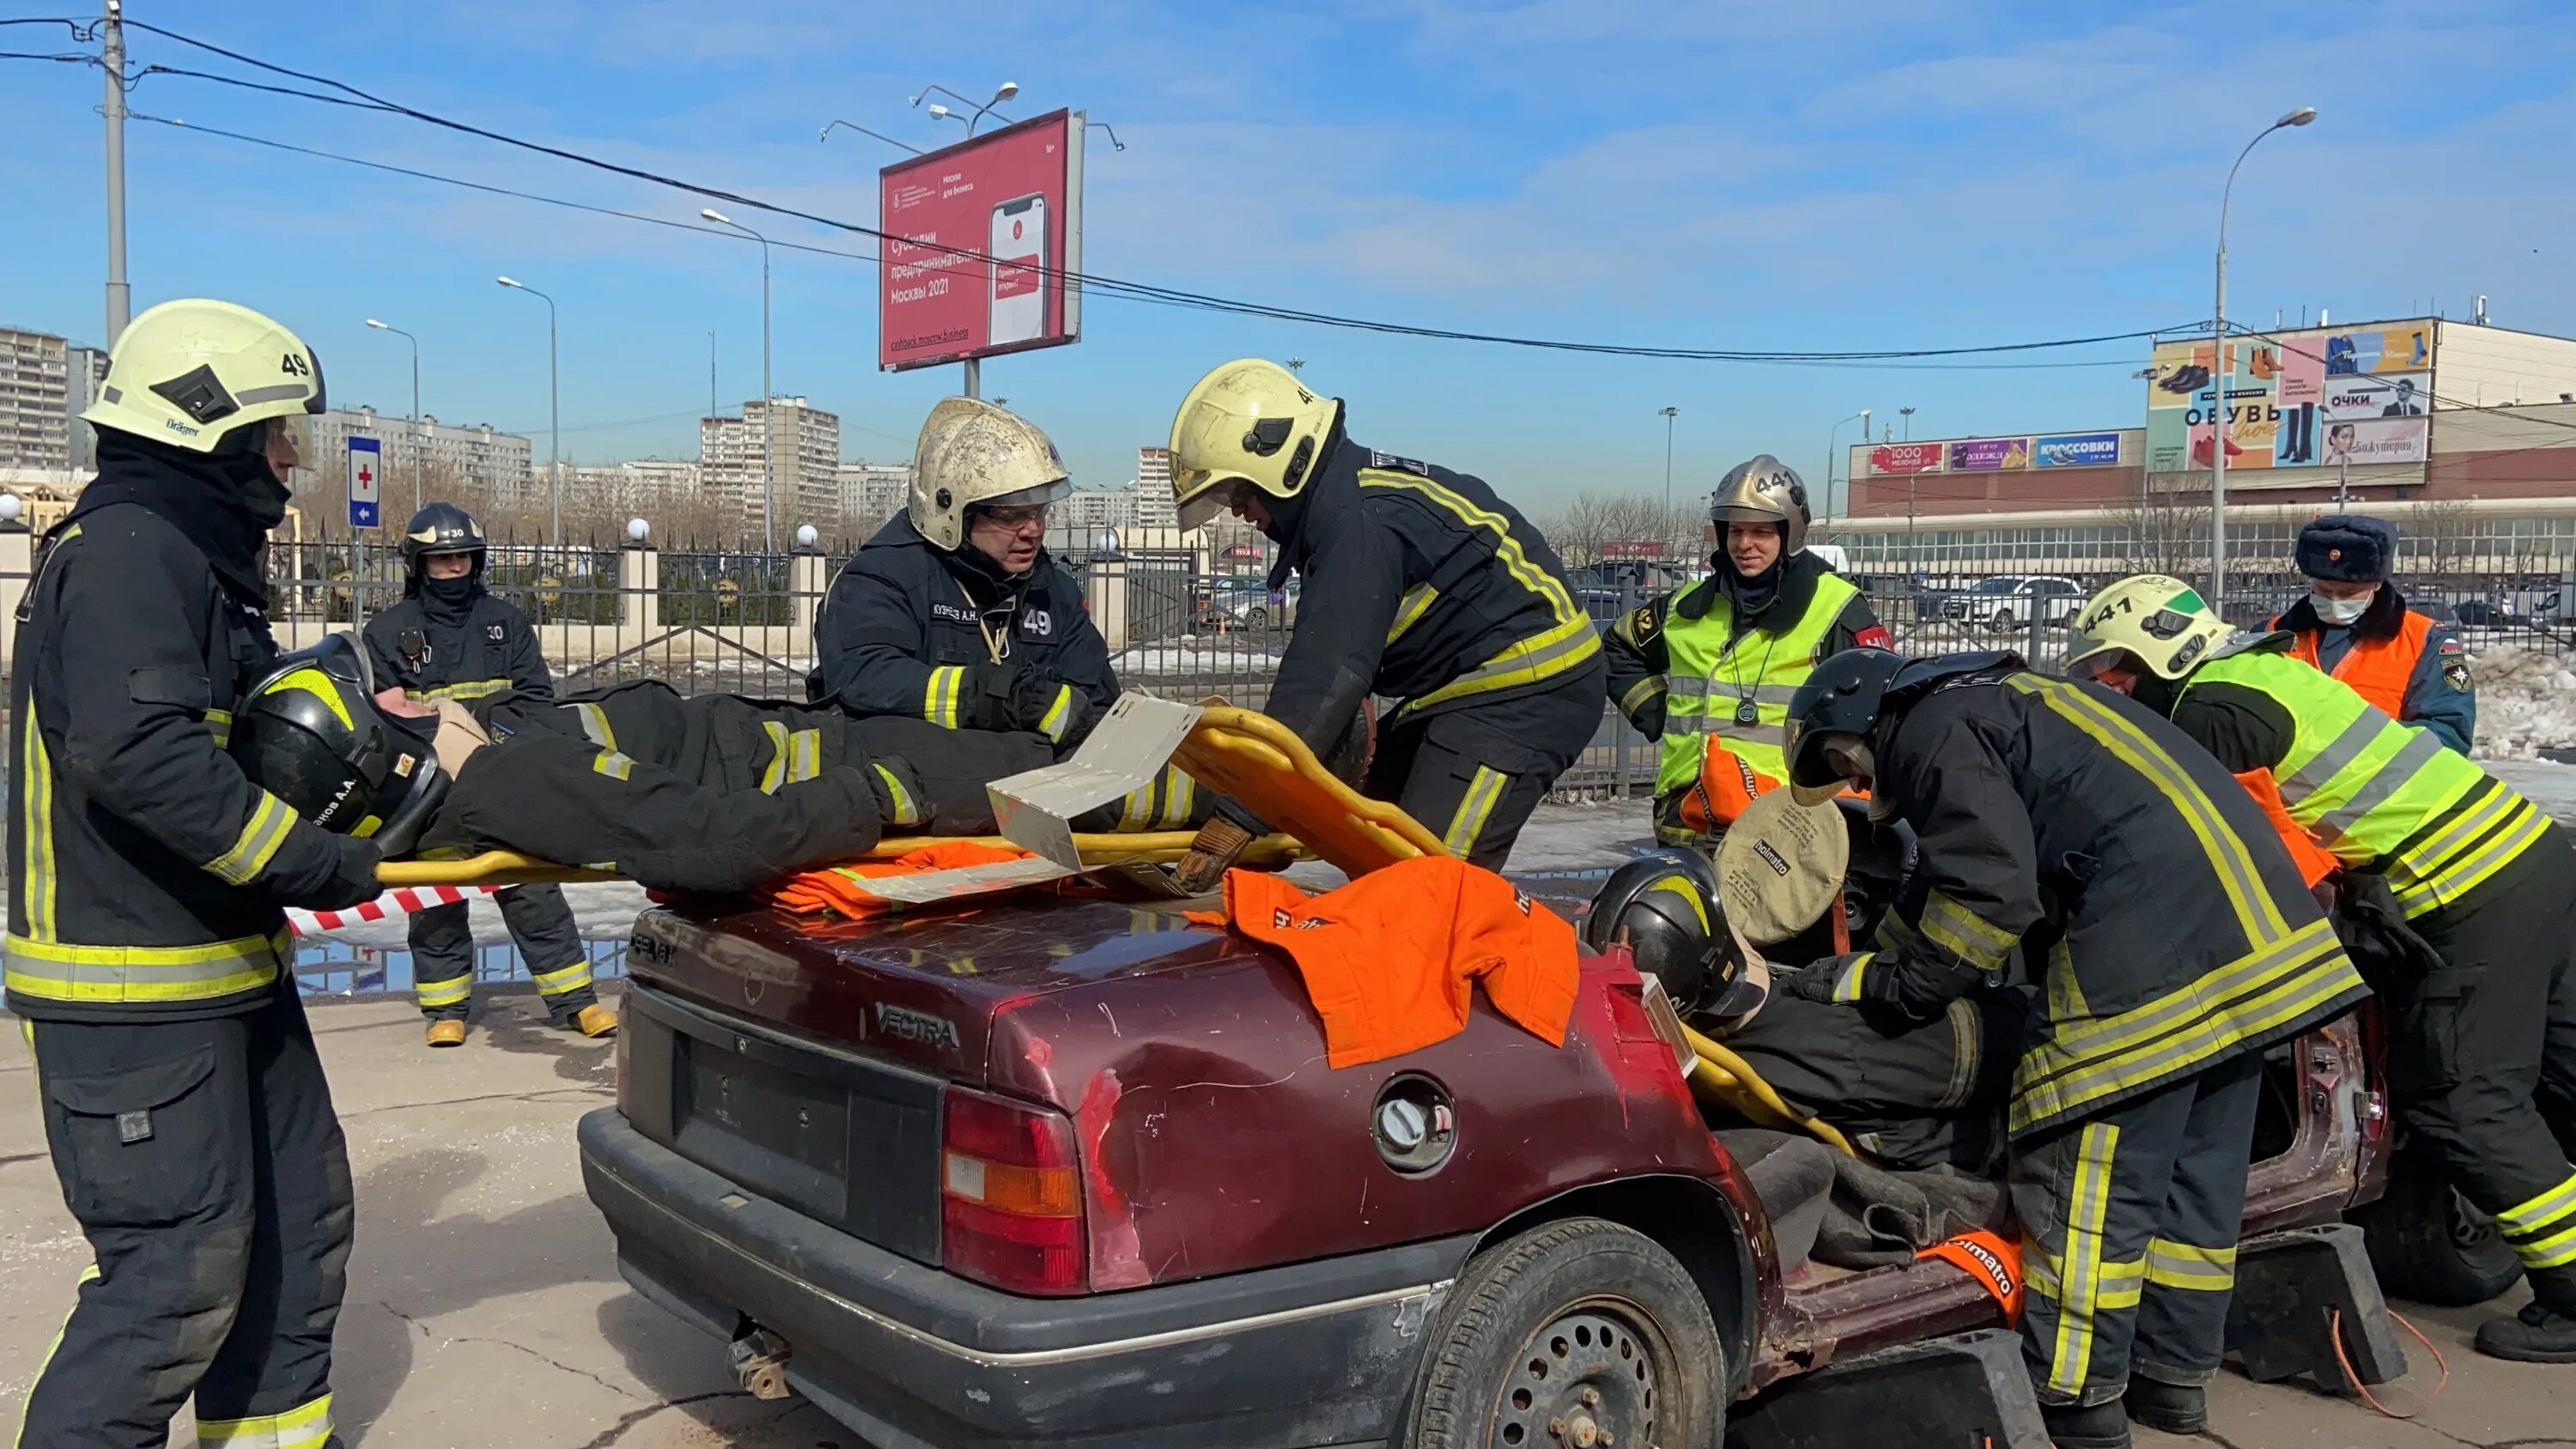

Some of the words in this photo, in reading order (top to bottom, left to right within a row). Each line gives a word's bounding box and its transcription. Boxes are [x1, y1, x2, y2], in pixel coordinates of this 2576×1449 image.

[891, 286, 927, 305] Москвы
[928, 277, 949, 297] 2021
[282, 353, 309, 376] 49
[2331, 394, 2370, 407] ОЧКИ
[2184, 404, 2281, 427] ОБУВЬ
[167, 418, 200, 436] Dräger
[1966, 451, 2011, 461] ОДЕЖДА
[2040, 440, 2115, 456] КРОССОВКИ
[2353, 440, 2412, 454] Бижутерия
[1756, 470, 1795, 493] 441
[451, 528, 465, 537] 30
[961, 610, 979, 621] А.Н.
[1024, 608, 1052, 635] 49
[2084, 596, 2133, 635] 441
[486, 625, 504, 640] 30
[1755, 838, 1789, 876] holmatro
[875, 1000, 961, 1050] VECTRA
